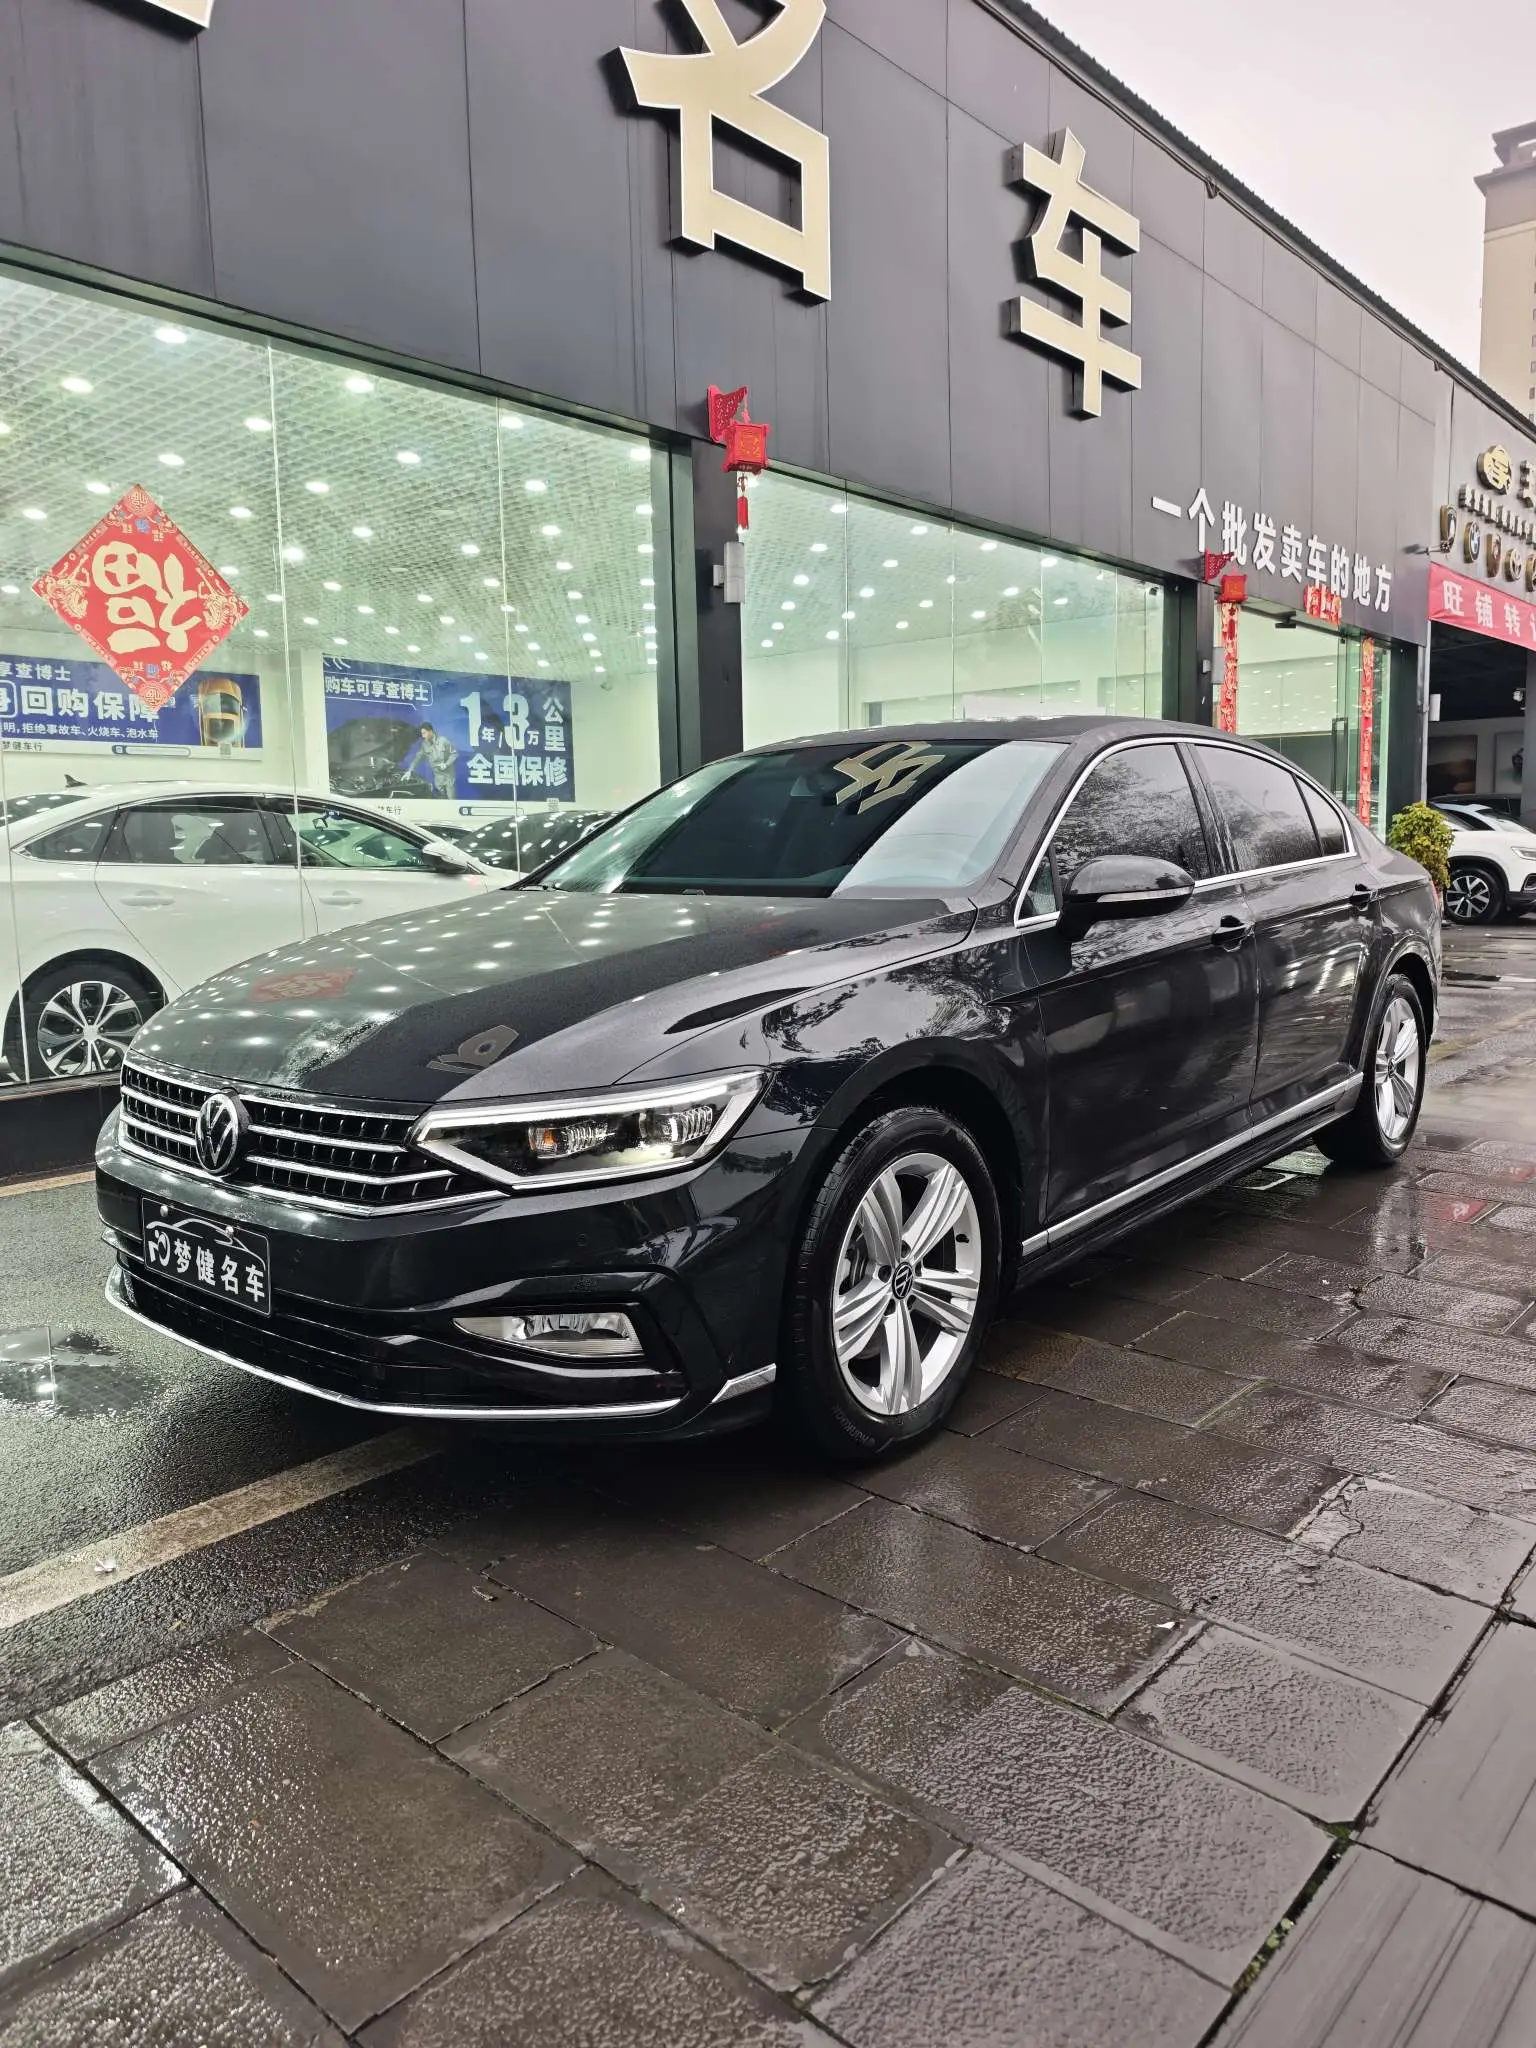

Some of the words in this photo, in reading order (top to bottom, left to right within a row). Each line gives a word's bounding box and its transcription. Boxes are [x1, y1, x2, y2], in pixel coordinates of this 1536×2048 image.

[1152, 487, 1392, 613] 一个批发卖车的地方
[92, 541, 202, 654] 福
[325, 676, 429, 702] 购车可享查博士
[466, 752, 568, 787] 全国保修
[174, 1238, 265, 1303] 梦健名车
